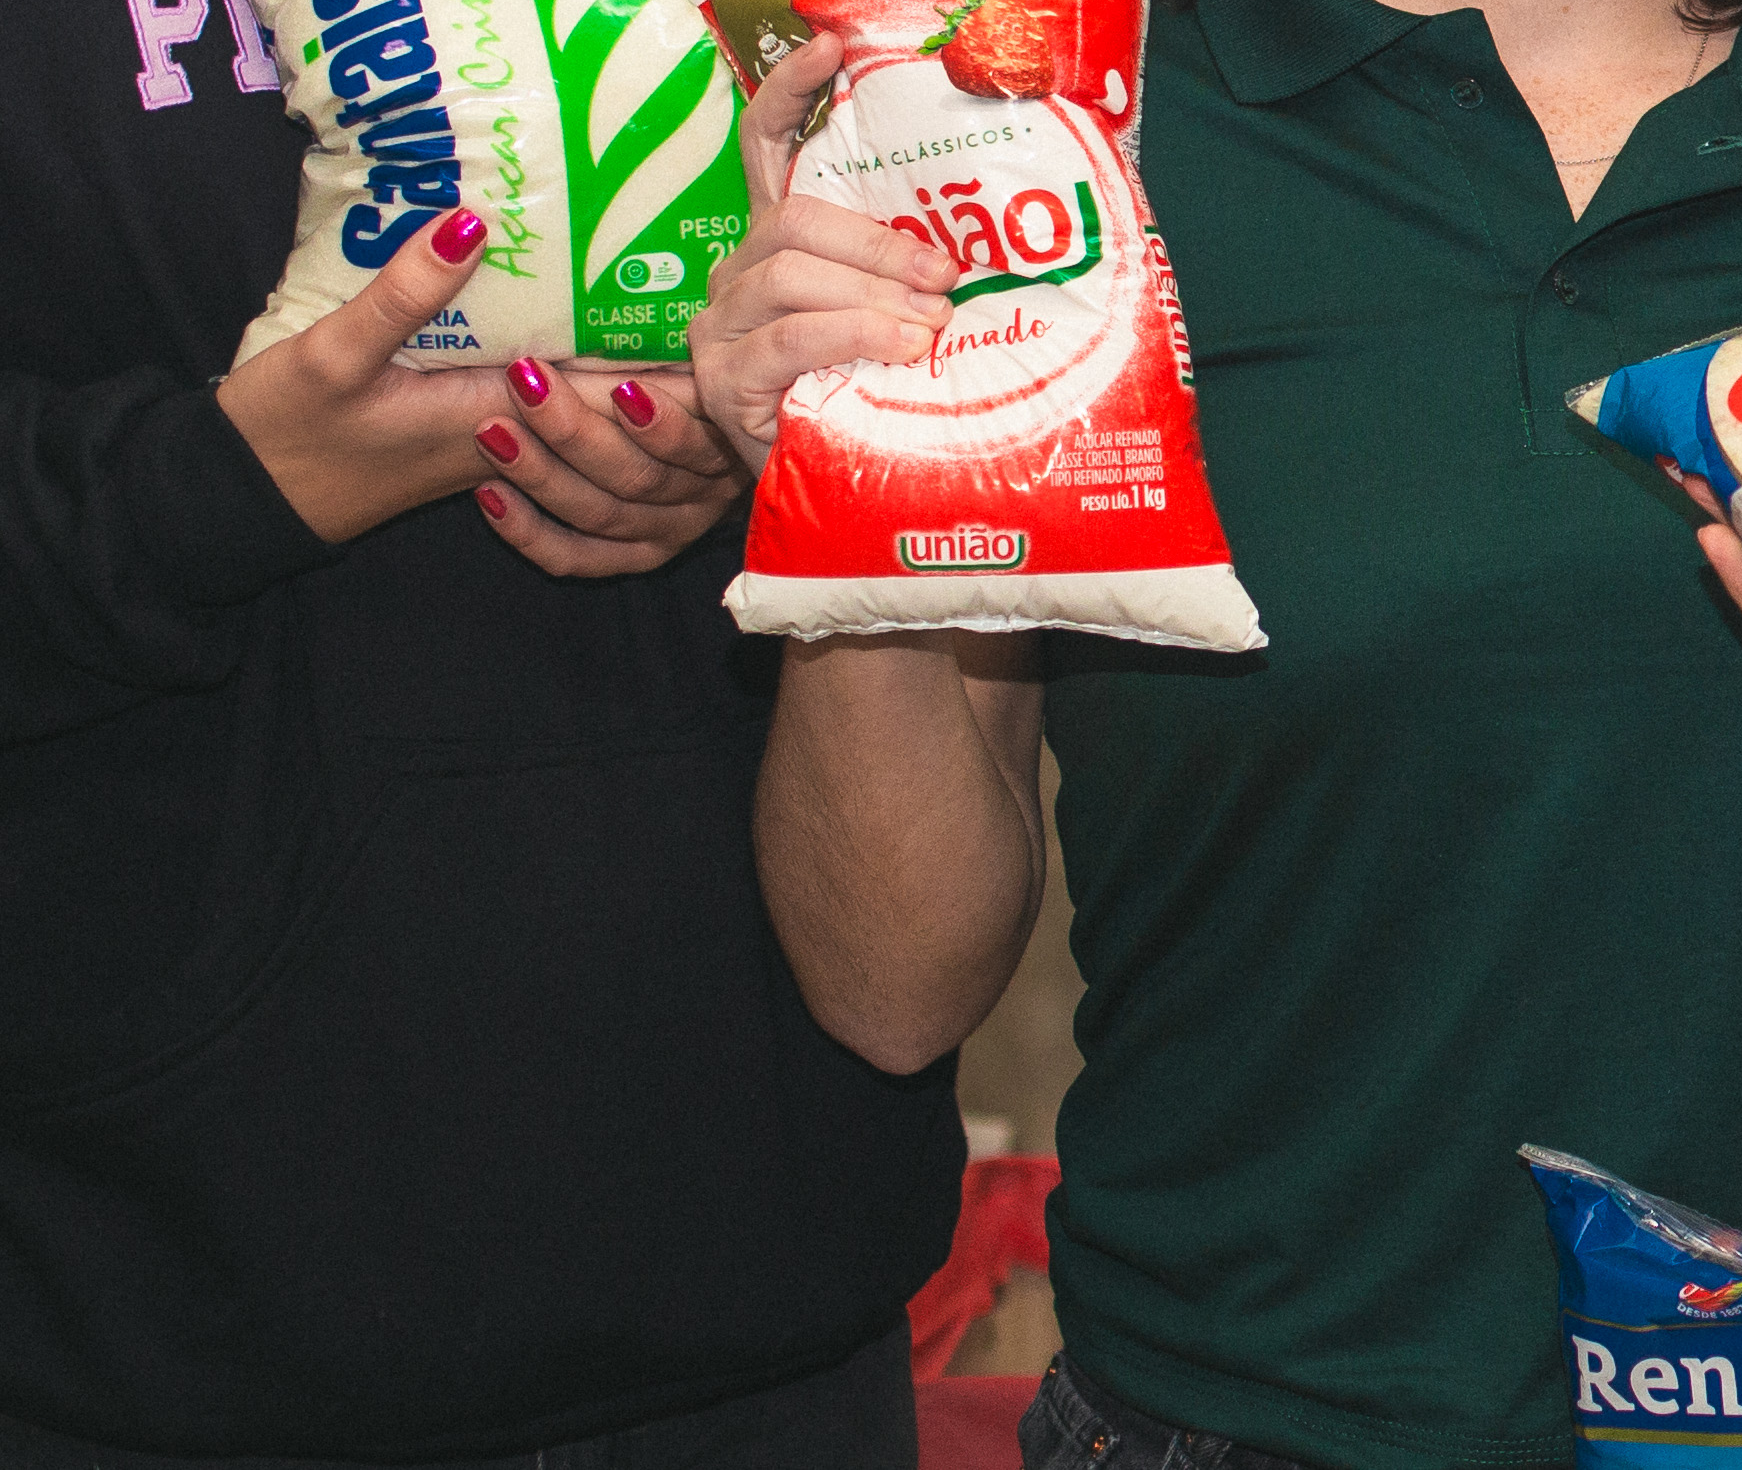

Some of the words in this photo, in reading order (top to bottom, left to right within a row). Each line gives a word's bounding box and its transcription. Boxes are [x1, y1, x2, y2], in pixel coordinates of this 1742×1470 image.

[891, 126, 1014, 166] CLÁSSICOS
[482, 107, 543, 279] Açúcar
[679, 214, 741, 240] PESO
[876, 176, 1073, 274] nião
[586, 303, 656, 326] CLASSE
[602, 332, 643, 351] TIPO
[884, 307, 1055, 379] finado
[1115, 429, 1161, 447] REFINADO
[1086, 450, 1123, 467] CRISTAL
[1124, 448, 1163, 465] BRANCO
[1050, 471, 1072, 487] TIPO
[1074, 468, 1122, 486] REFINADO
[1125, 466, 1164, 483] AMORFO
[1081, 495, 1109, 511] PESO
[1144, 484, 1166, 511] kg
[909, 527, 1016, 564] união
[1677, 1302, 1718, 1319] DESDE
